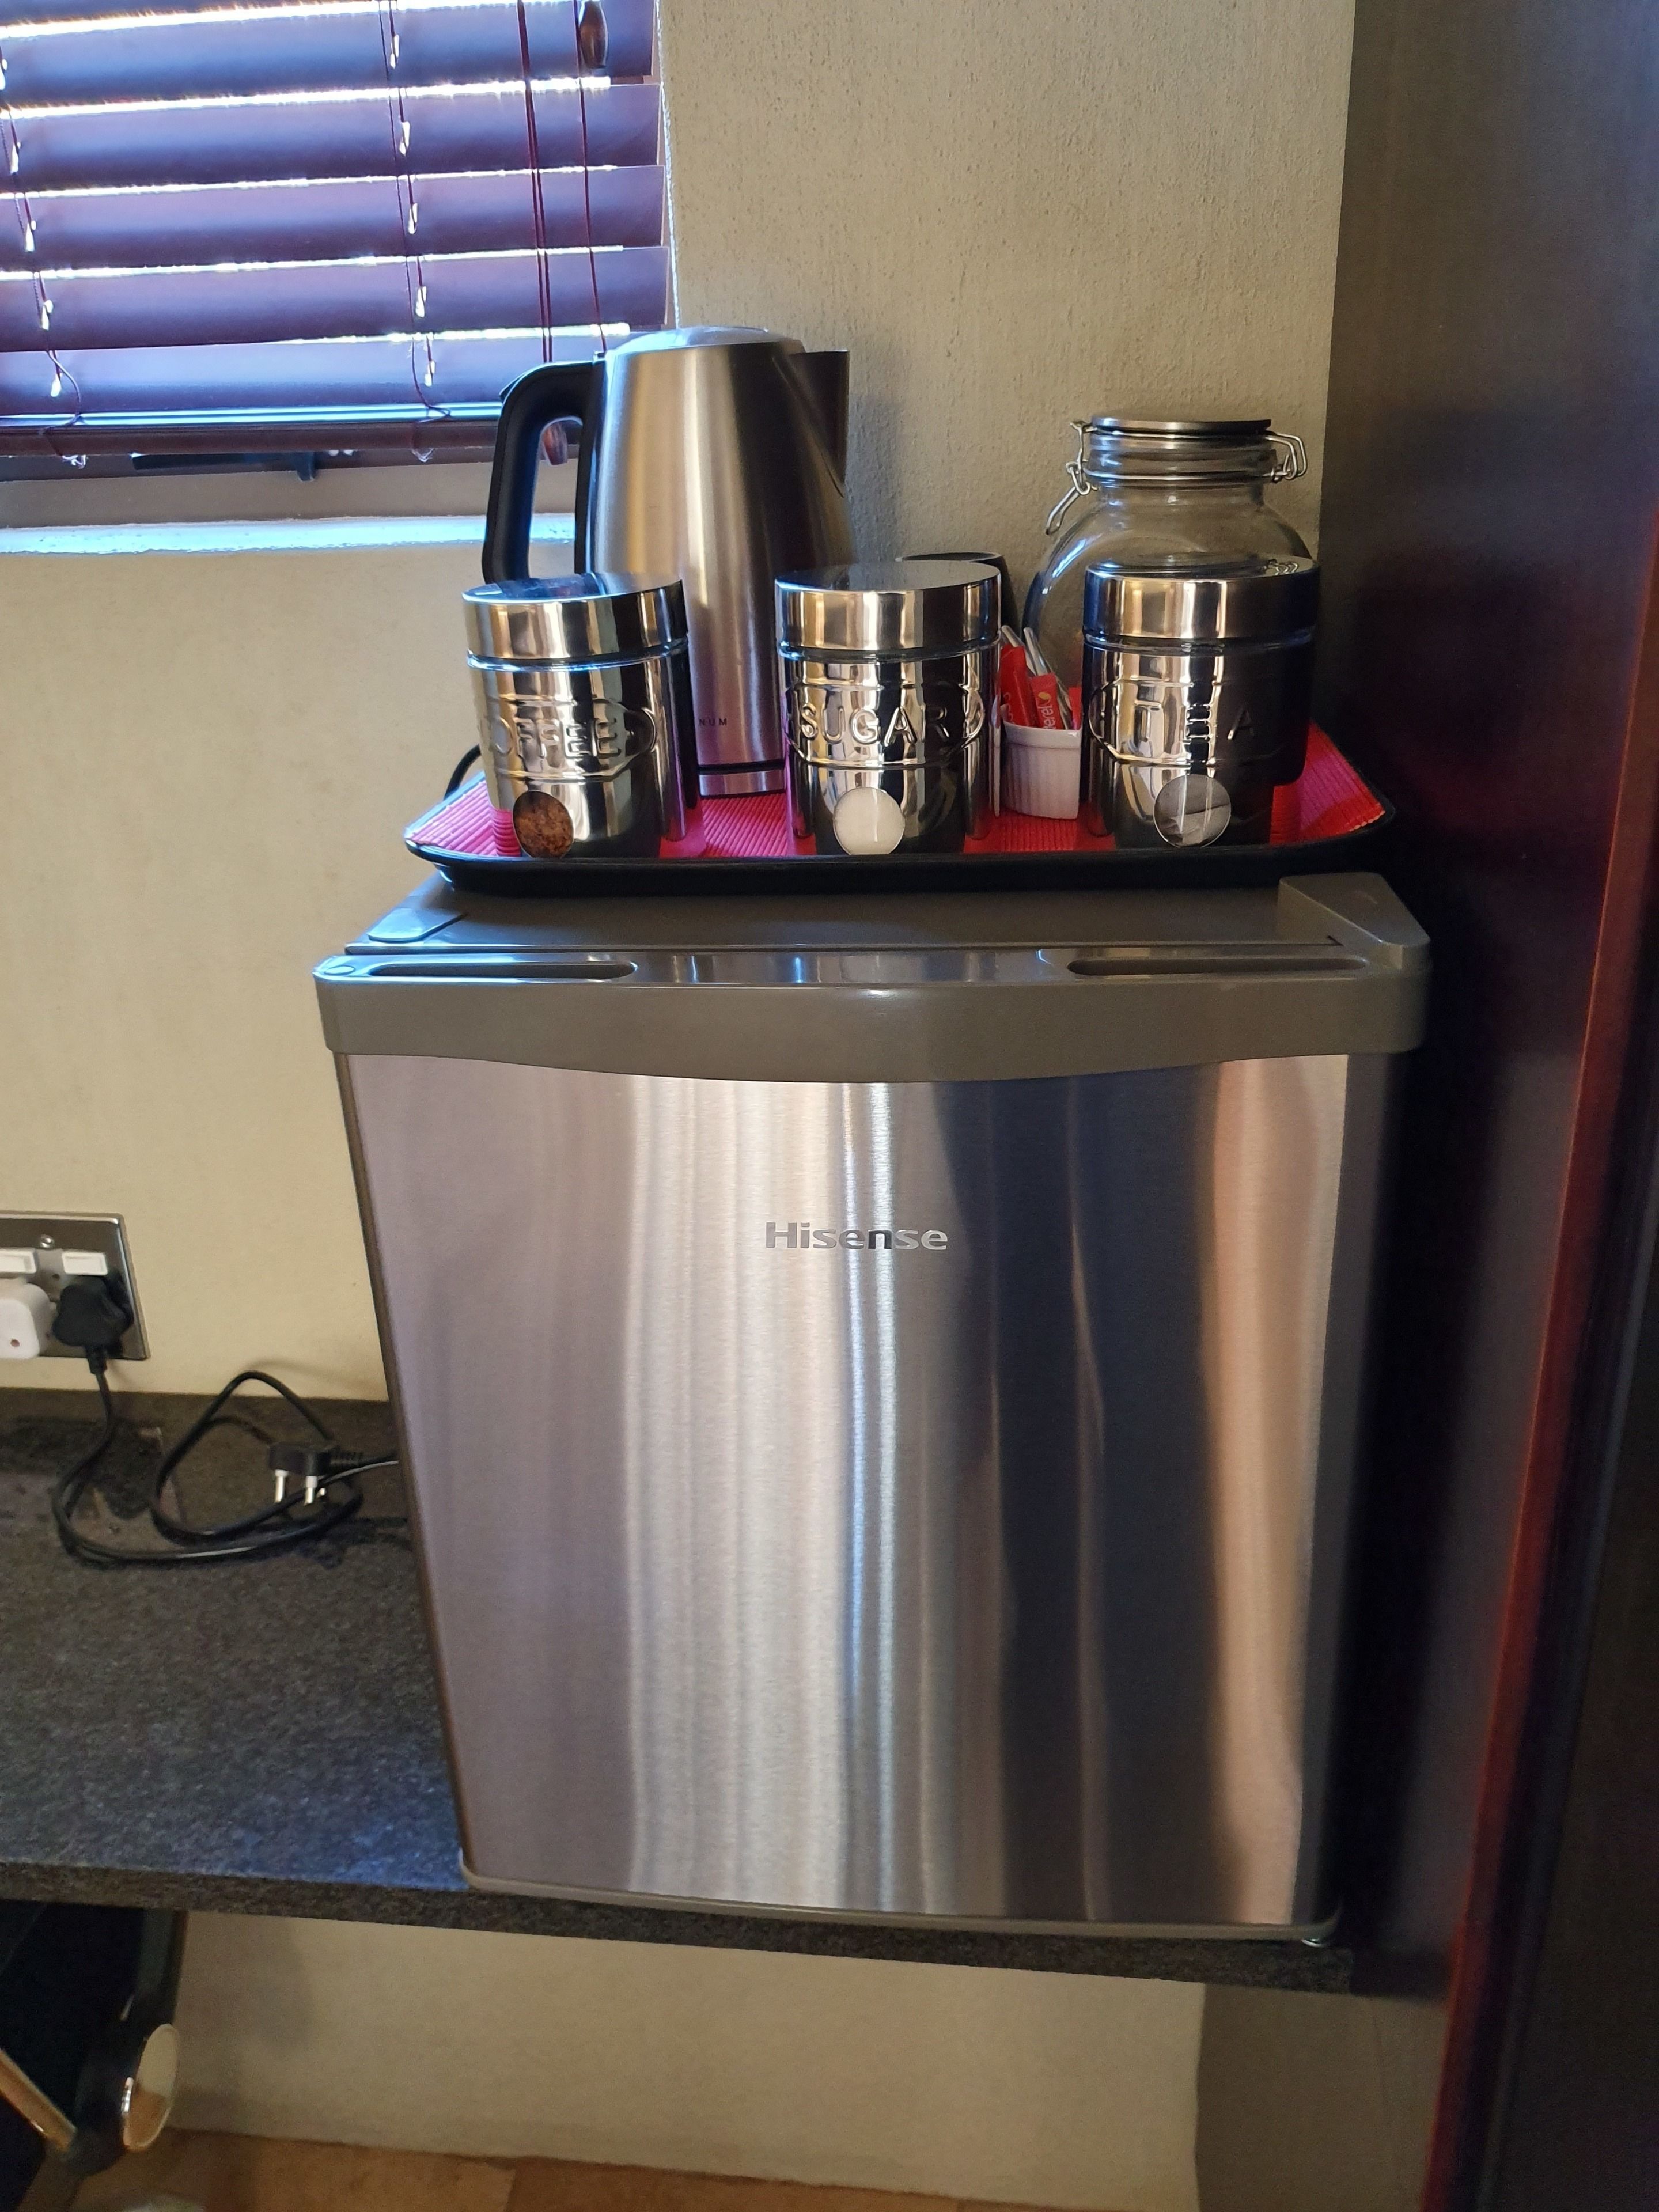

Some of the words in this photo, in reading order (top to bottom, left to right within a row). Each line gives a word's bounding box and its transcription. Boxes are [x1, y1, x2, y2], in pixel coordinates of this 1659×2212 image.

[487, 715, 622, 759] OFFEE
[698, 718, 728, 726] NUM
[801, 703, 950, 747] SUGAR
[1134, 699, 1256, 744] TEA
[766, 1221, 948, 1250] Hisense
